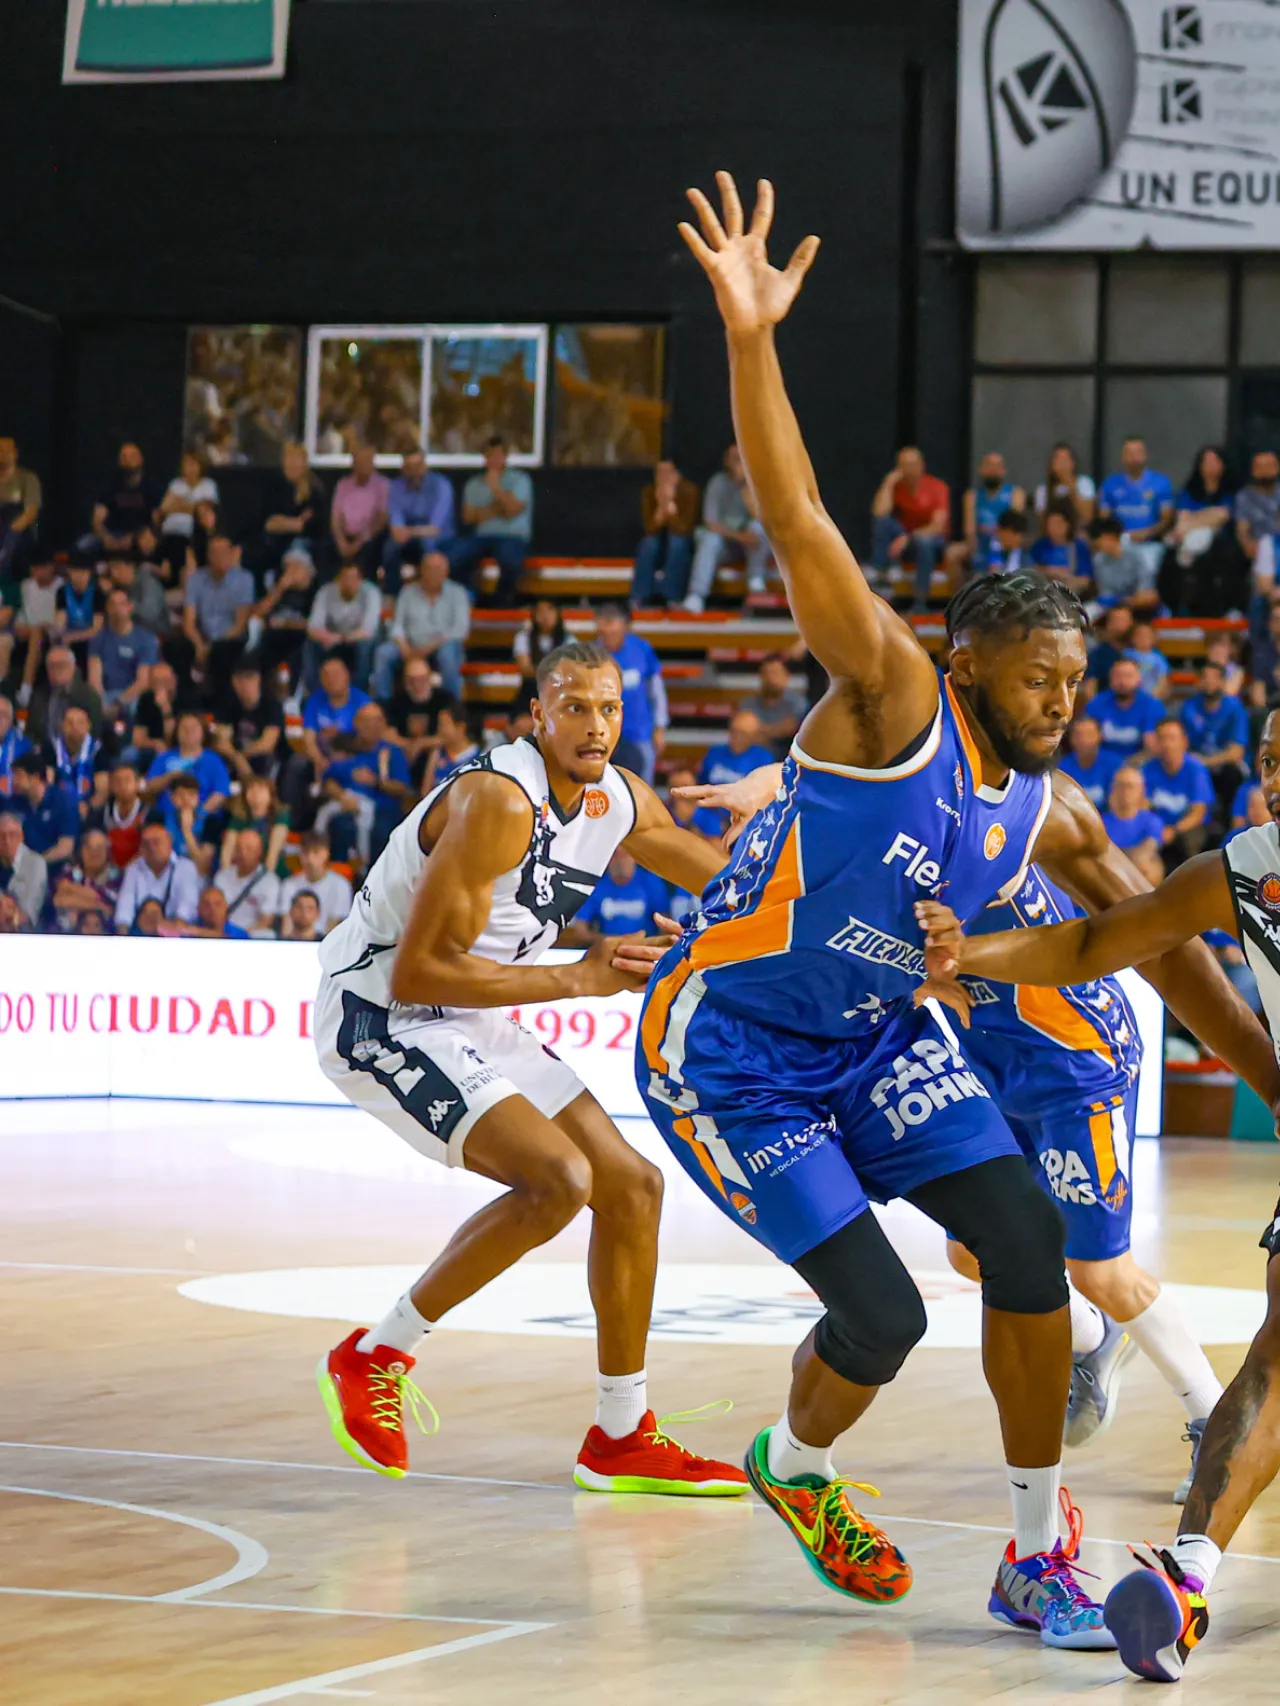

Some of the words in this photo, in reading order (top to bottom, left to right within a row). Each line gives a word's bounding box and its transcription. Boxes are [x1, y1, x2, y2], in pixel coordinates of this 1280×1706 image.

[1120, 172, 1176, 204] UN
[47, 992, 78, 1033] TU
[89, 992, 276, 1038] CIUDAD
